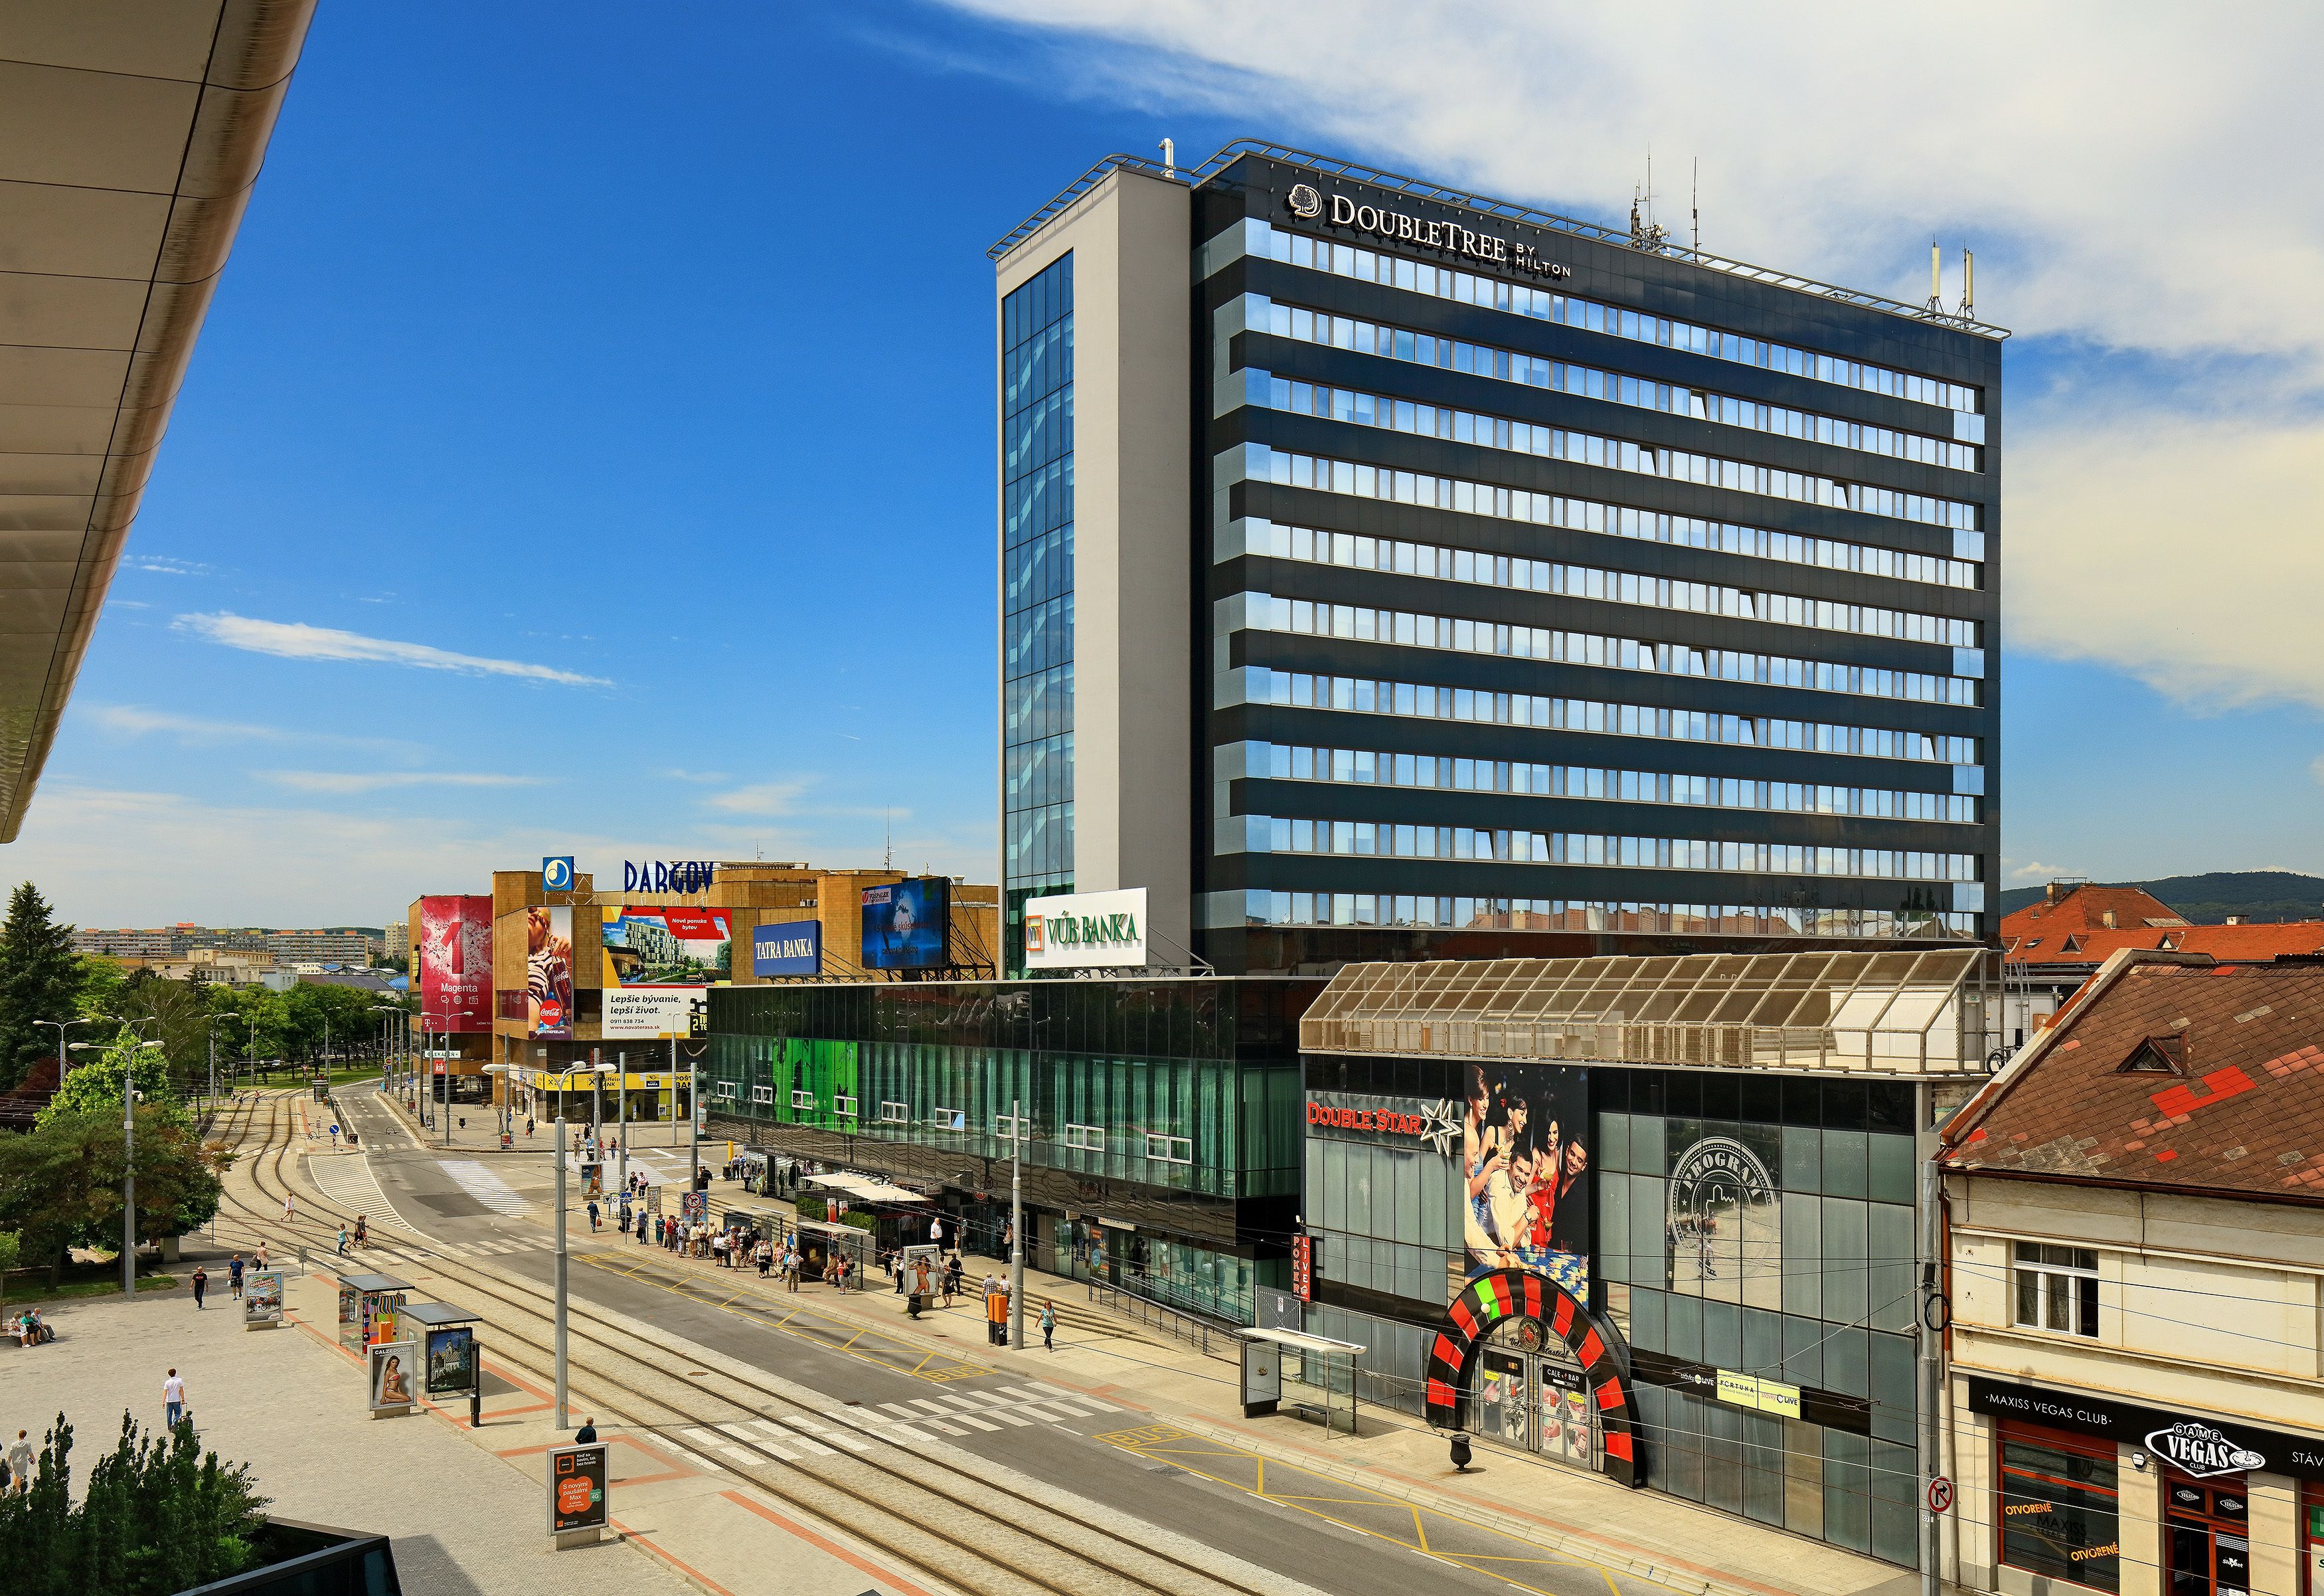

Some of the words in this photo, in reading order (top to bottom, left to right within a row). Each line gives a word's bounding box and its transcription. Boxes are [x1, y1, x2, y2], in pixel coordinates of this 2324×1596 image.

[1516, 242, 1536, 255] BY
[1516, 256, 1572, 278] HILTON
[625, 859, 714, 895] DARGOV
[1046, 910, 1079, 944] VÚB
[1082, 913, 1139, 943] BANKA
[756, 941, 782, 960] TATRA
[784, 938, 813, 958] BANKA
[441, 983, 478, 994] Magenta
[610, 995, 640, 1004] Lepšie
[642, 995, 681, 1004] bývanie,
[610, 1006, 634, 1016] lepší
[635, 1006, 661, 1014] život.
[1683, 1152, 1763, 1198] PROGRAM
[924, 1368, 985, 1380] BUS
[1568, 1374, 1580, 1382] BAR
[1701, 1377, 1714, 1386] LIVE
[1761, 1392, 1776, 1401] stávky
[1784, 1396, 1798, 1406] LIVE
[1989, 1393, 2029, 1410] MAXISS
[2033, 1401, 2072, 1419] VEGAS
[2077, 1410, 2107, 1425] CLUB
[1107, 1427, 1181, 1445] BUS
[2176, 1424, 2219, 1442] GAME
[2167, 1434, 2229, 1468] VEGAS
[563, 1487, 588, 1496] paušálmi
[2005, 1500, 2052, 1516] OTVORENÉ
[2071, 1542, 2119, 1561] OTVORENÉ
